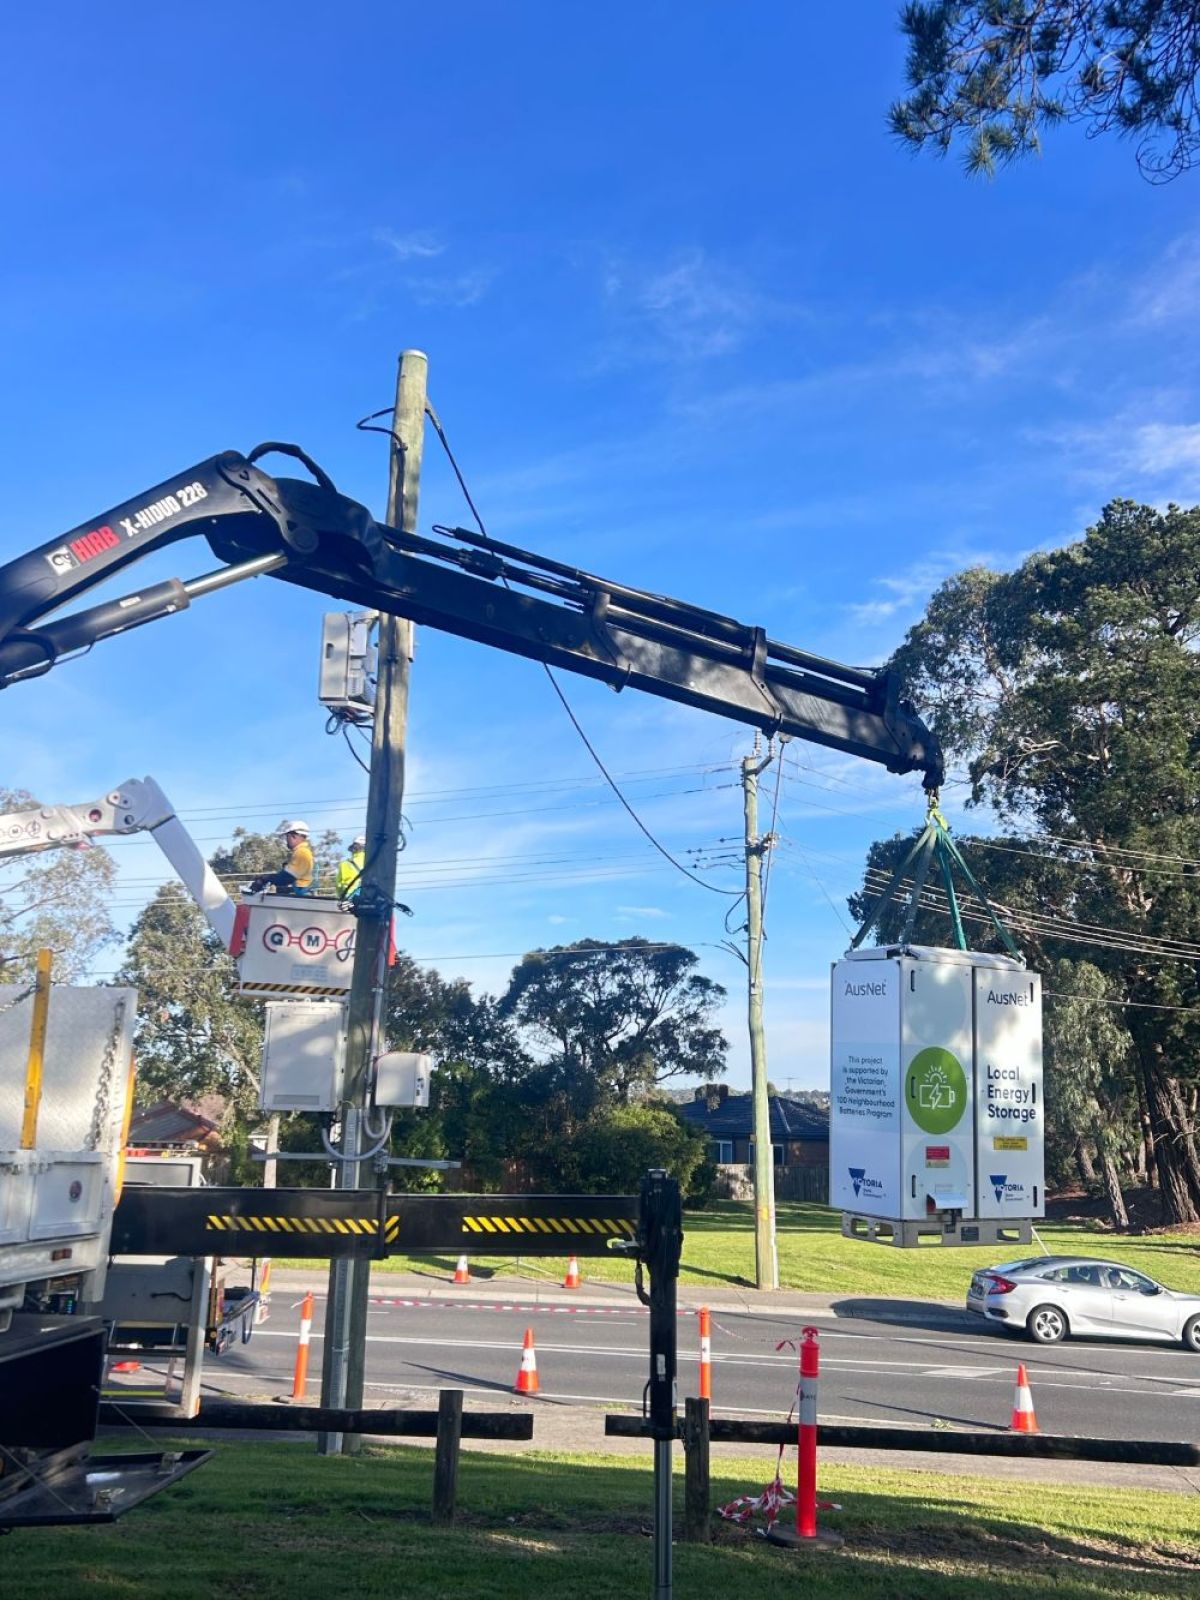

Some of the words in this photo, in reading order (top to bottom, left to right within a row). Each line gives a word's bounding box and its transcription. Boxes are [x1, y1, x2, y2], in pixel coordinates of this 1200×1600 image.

[70, 525, 121, 563] HIAB
[844, 982, 887, 996] AusNet
[987, 990, 1029, 1007] AusNet
[849, 1067, 879, 1076] supported
[987, 1064, 1020, 1080] Local
[987, 1084, 1030, 1103] Energy
[848, 1098, 896, 1108] Neighbourhood
[987, 1103, 1037, 1123] Storage
